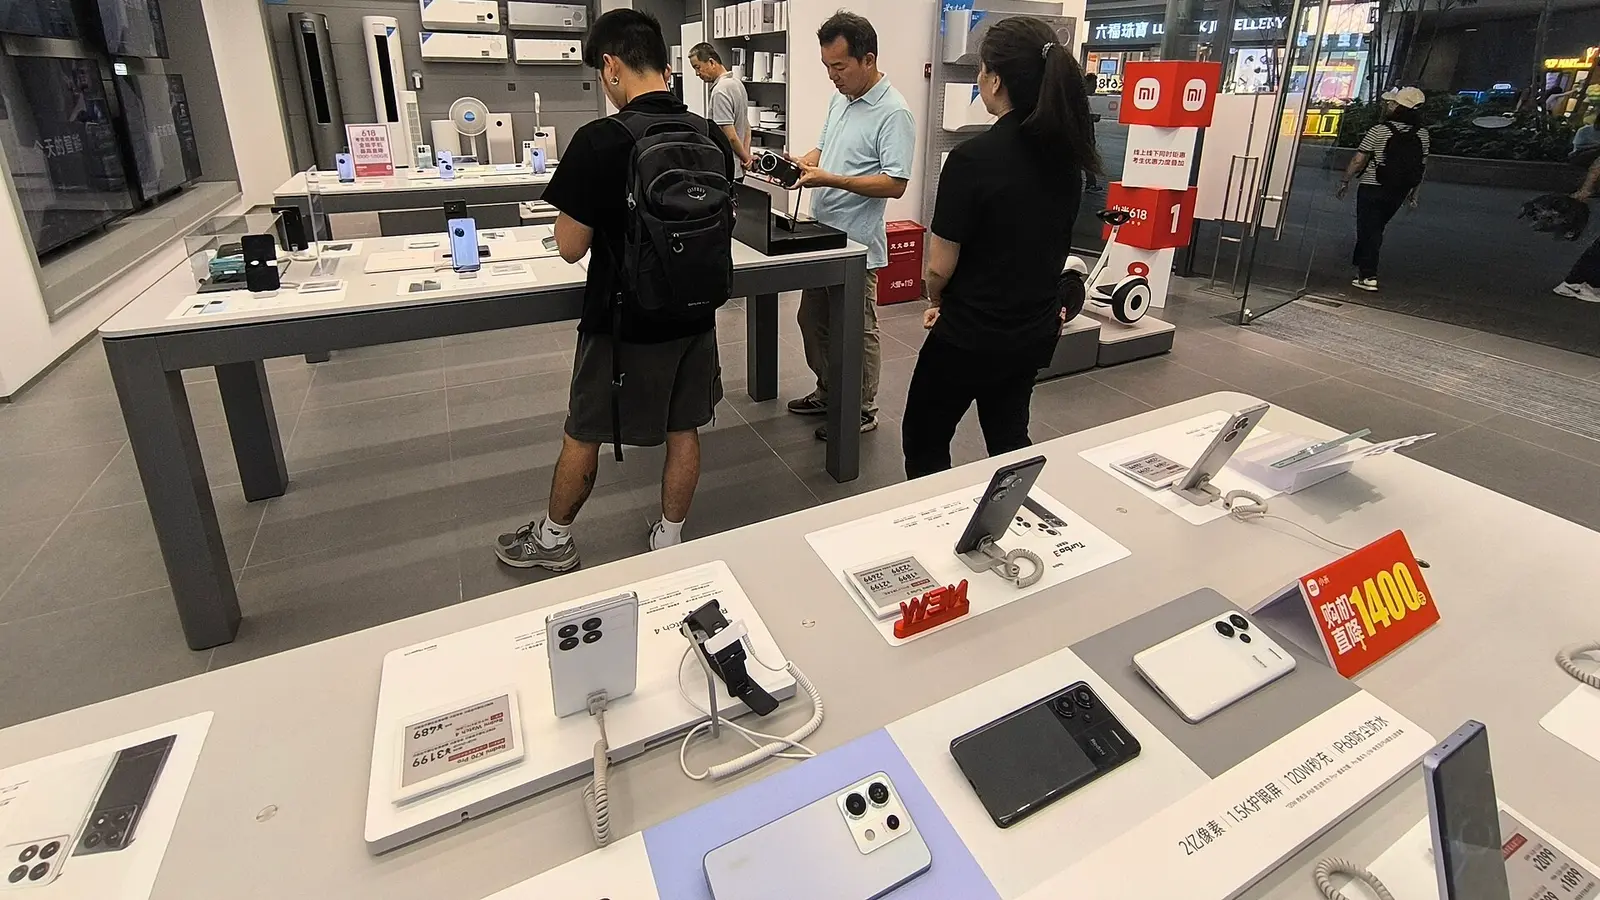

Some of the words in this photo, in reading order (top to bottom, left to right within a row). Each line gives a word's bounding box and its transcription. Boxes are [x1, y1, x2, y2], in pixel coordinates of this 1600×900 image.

[1095, 21, 1150, 40] 六福珠寶
[361, 129, 377, 137] 618
[1170, 203, 1181, 234] 1
[1320, 593, 1357, 630] 购机
[1330, 617, 1366, 656] 直降
[413, 723, 444, 740] ¥489
[412, 746, 451, 768] ¥3199
[1178, 819, 1227, 856] 2亿像素
[1226, 781, 1284, 824] 1.5K护眼屏
[1283, 751, 1334, 786] 120W秒充
[1331, 715, 1390, 754] IP68防尘防水
